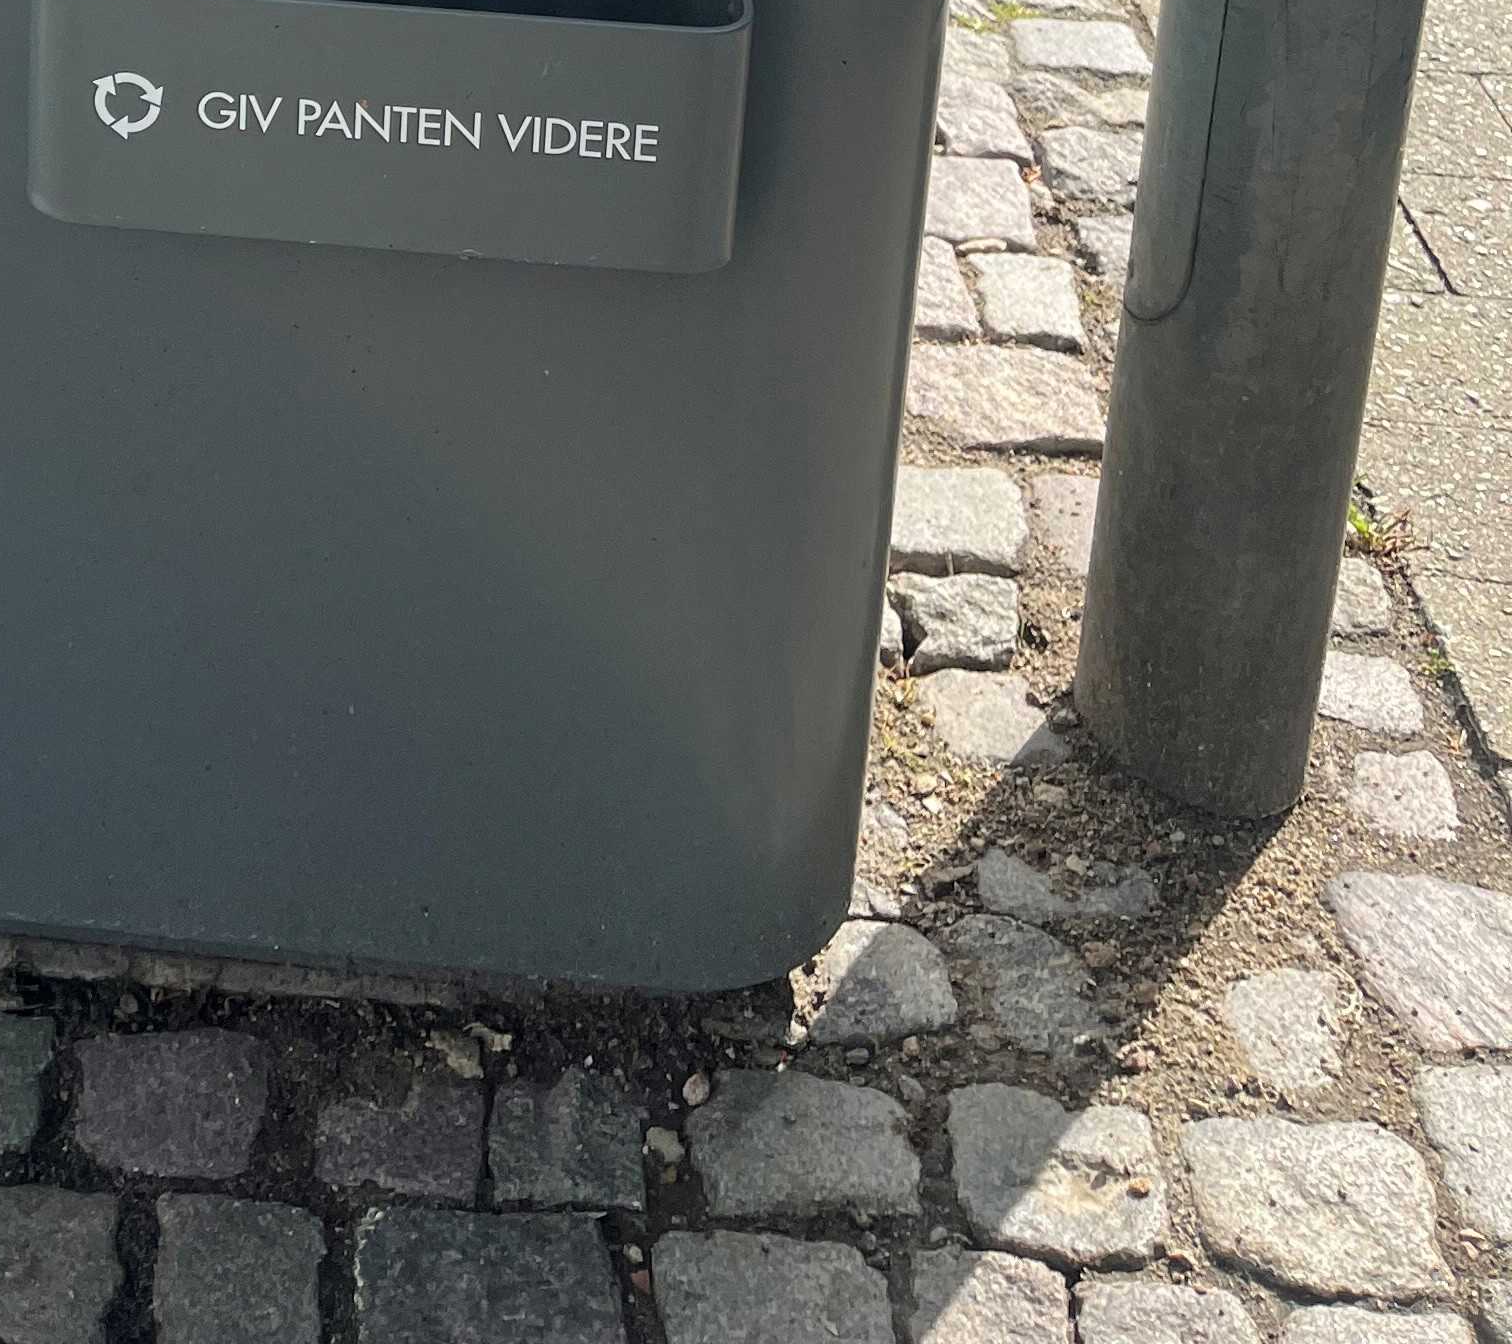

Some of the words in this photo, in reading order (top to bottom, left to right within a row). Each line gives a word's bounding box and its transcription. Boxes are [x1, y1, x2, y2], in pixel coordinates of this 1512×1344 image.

[198, 92, 282, 133] GIV
[298, 99, 481, 149] PANTEN
[498, 114, 658, 161] VIDERE
